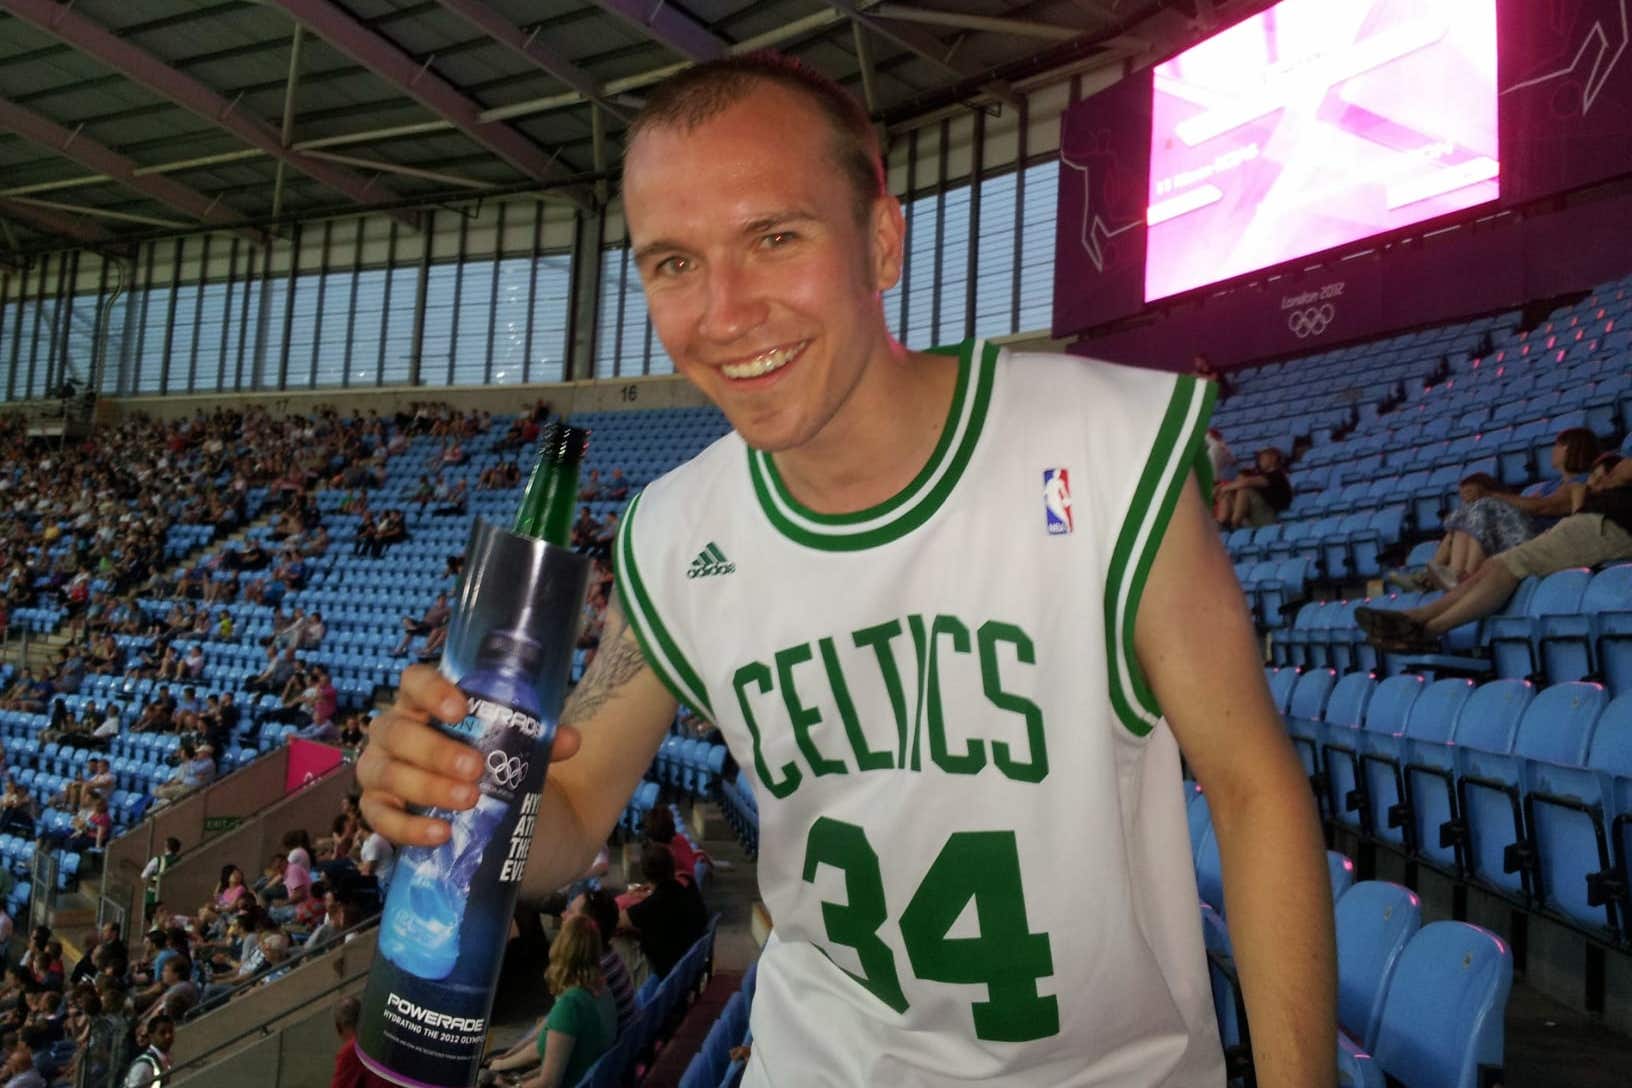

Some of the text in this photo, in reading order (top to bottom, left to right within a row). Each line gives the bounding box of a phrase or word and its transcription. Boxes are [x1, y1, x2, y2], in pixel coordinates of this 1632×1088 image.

[1281, 282, 1345, 310] London 2012
[620, 384, 638, 402] 16
[686, 561, 737, 579] adidas
[733, 613, 1050, 800] CELTICS
[802, 815, 1060, 1043] 34
[383, 1009, 422, 1035] HYDRATING
[423, 1027, 440, 1041] THE
[440, 1032, 460, 1044] 2012
[387, 992, 485, 1033] POWERADE
